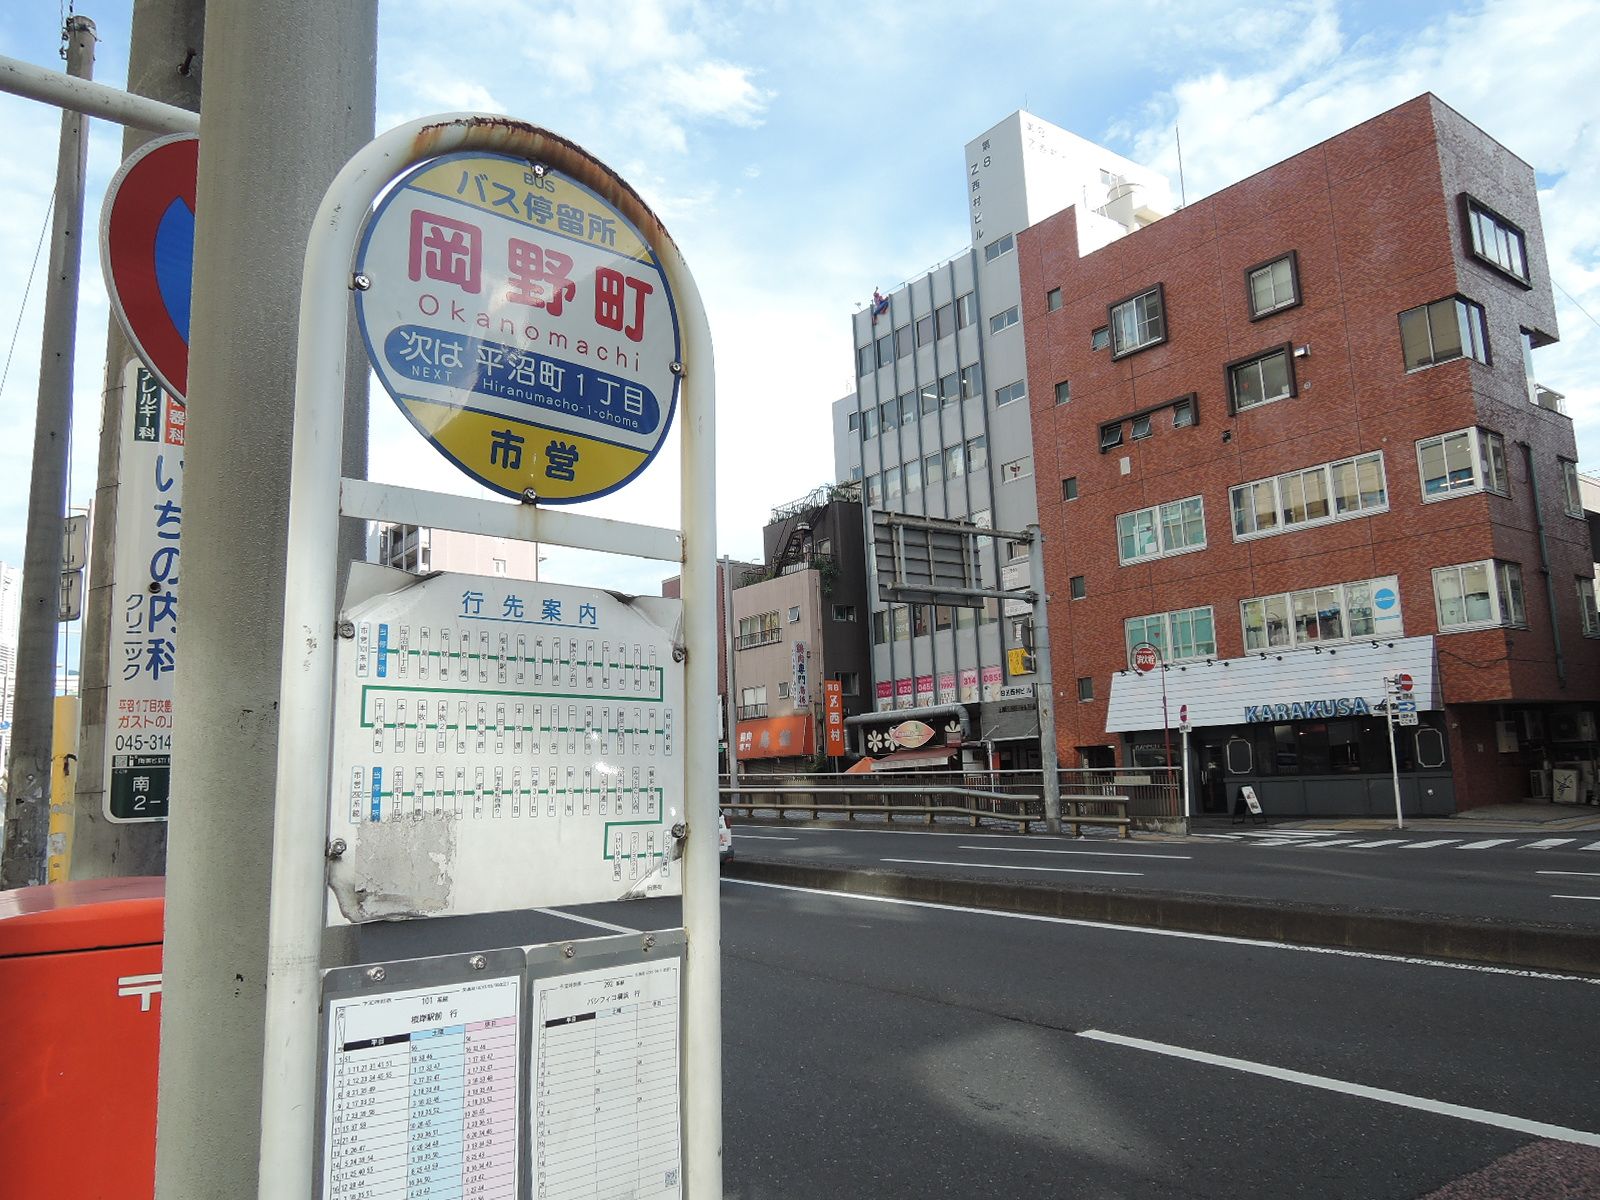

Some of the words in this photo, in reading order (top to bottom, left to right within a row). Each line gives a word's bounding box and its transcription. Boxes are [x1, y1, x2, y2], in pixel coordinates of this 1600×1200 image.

[523, 171, 556, 194] BUS
[456, 170, 617, 247] バス停留所
[407, 208, 655, 343] 岡野町
[417, 293, 641, 373] Okanomachi
[399, 330, 464, 369] 次は
[411, 364, 453, 382] NEXT
[489, 429, 580, 482] 市営
[462, 590, 597, 625] 行先案内
[123, 594, 144, 681] クリニック
[1137, 654, 1155, 664] 消火栓
[963, 677, 977, 685] 314
[1244, 697, 1370, 723] KARAKUSA
[115, 734, 171, 751] 045-314
[422, 995, 433, 1005] 101
[587, 991, 630, 1006] パシフィコ横浜
[411, 1010, 443, 1024] 根岸駅前
[370, 1037, 385, 1047] 平日
